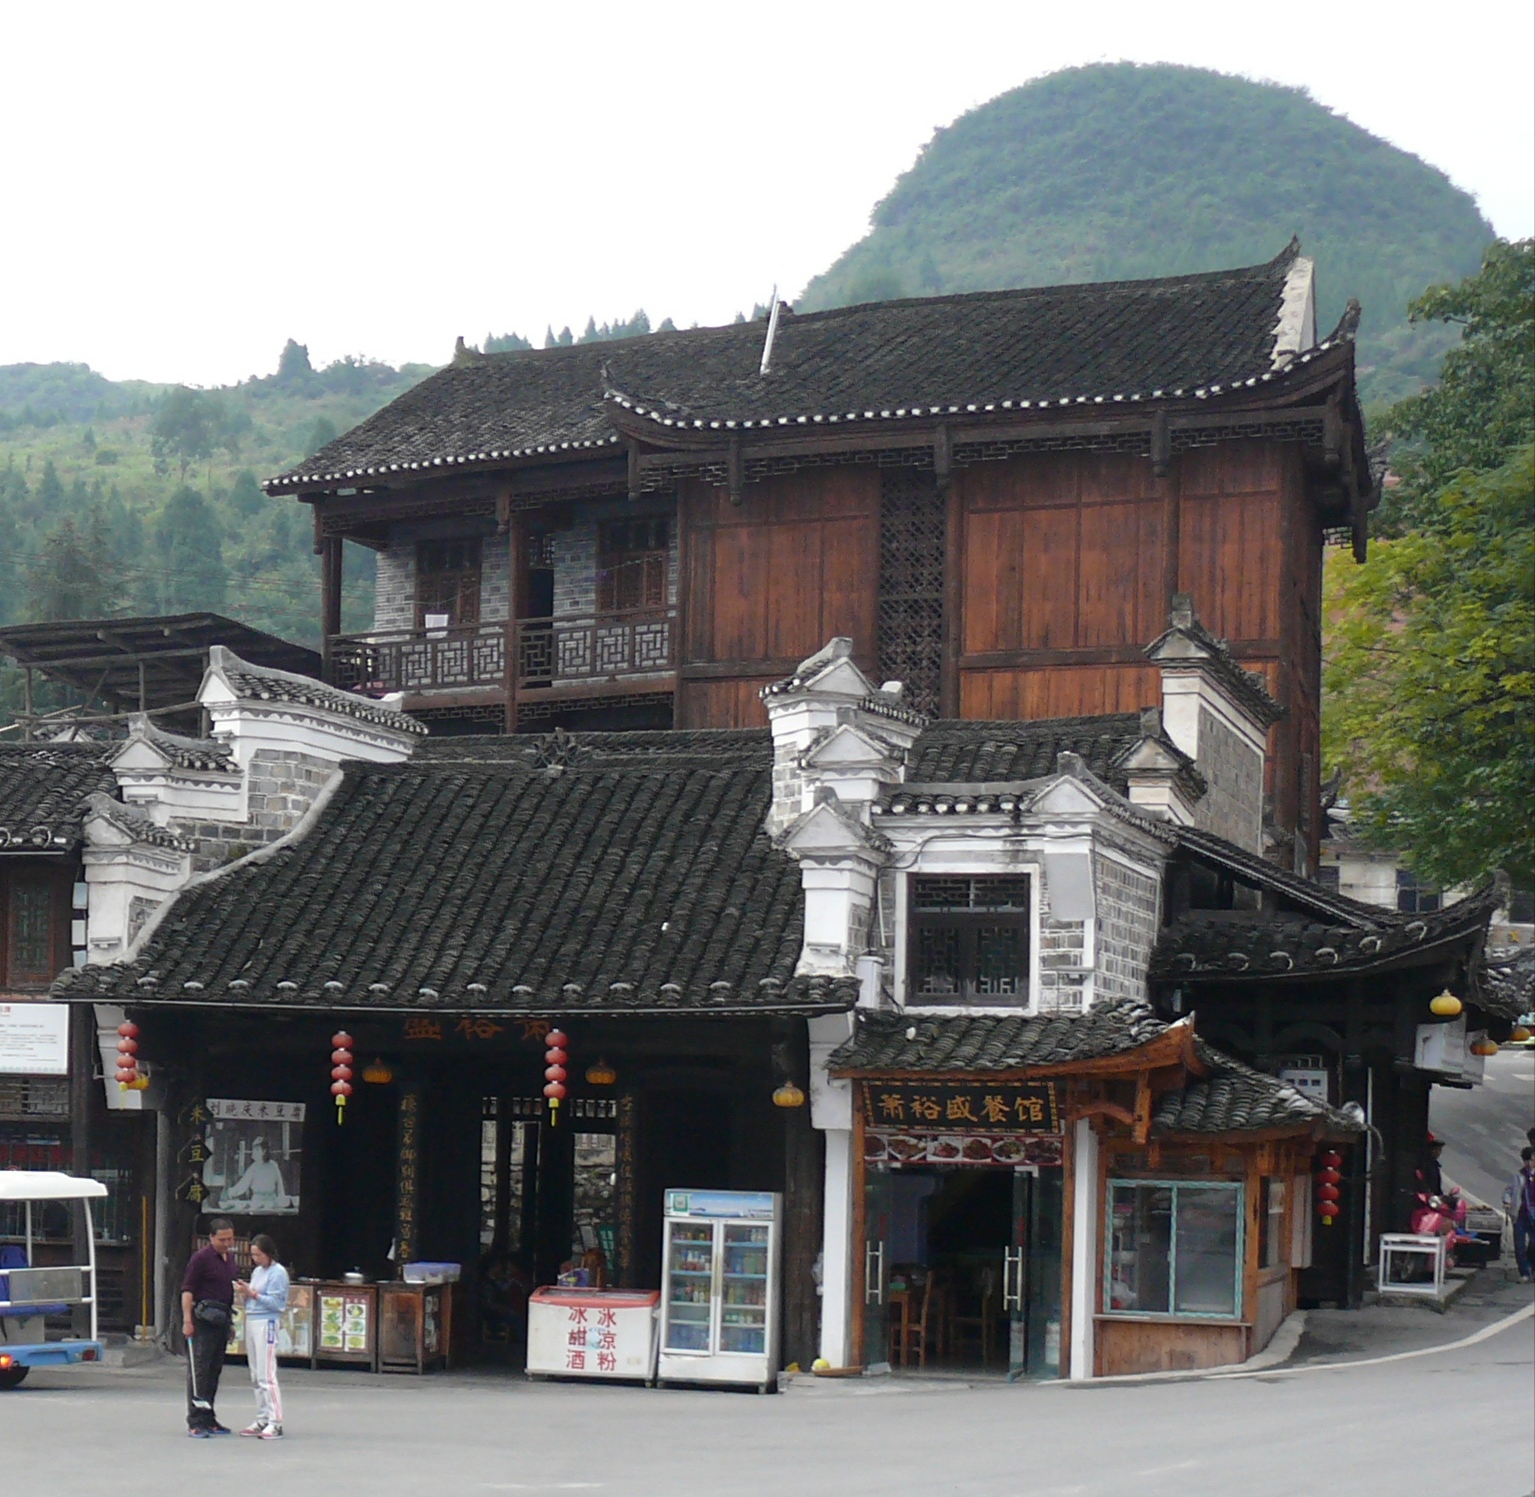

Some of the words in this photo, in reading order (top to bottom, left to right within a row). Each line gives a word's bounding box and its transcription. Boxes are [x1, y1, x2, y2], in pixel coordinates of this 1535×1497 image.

[566, 1306, 588, 1370] 冰甜酒
[597, 1308, 617, 1371] 冰凉粉
